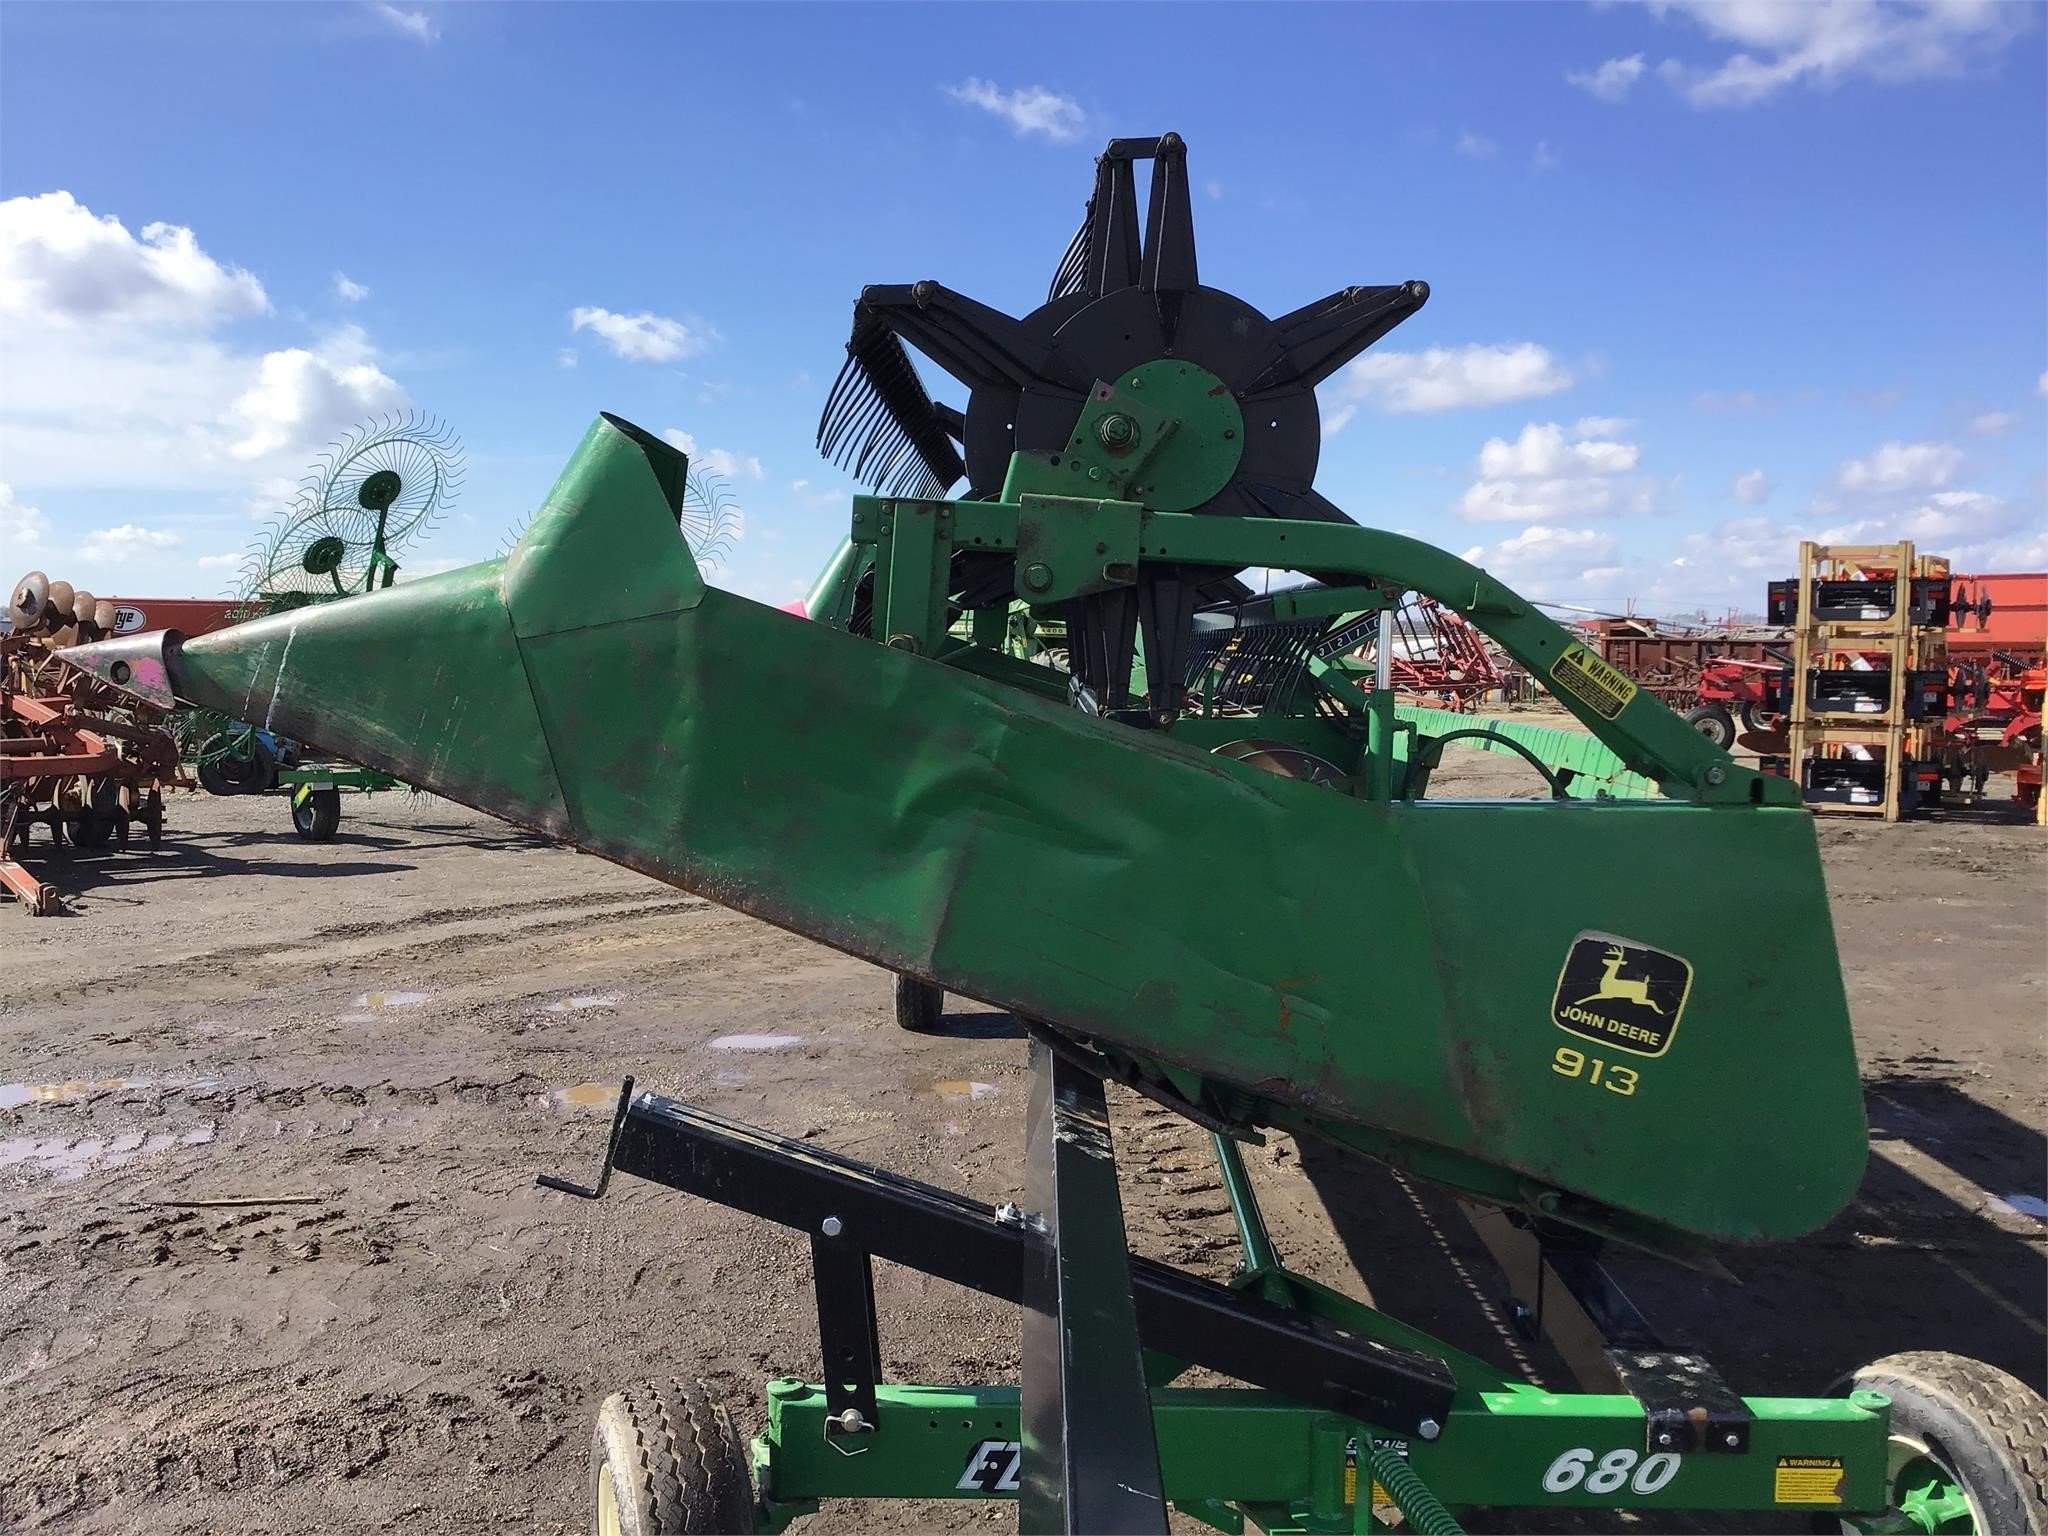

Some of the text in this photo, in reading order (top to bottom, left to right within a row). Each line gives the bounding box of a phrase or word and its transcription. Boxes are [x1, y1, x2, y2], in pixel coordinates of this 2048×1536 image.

[1586, 659, 1633, 700] WARNING
[1559, 1005, 1662, 1047] JOHN DEERE
[1551, 1047, 1640, 1096] 913
[1542, 1448, 1682, 1496] 680
[1789, 1459, 1831, 1467] WARNING
